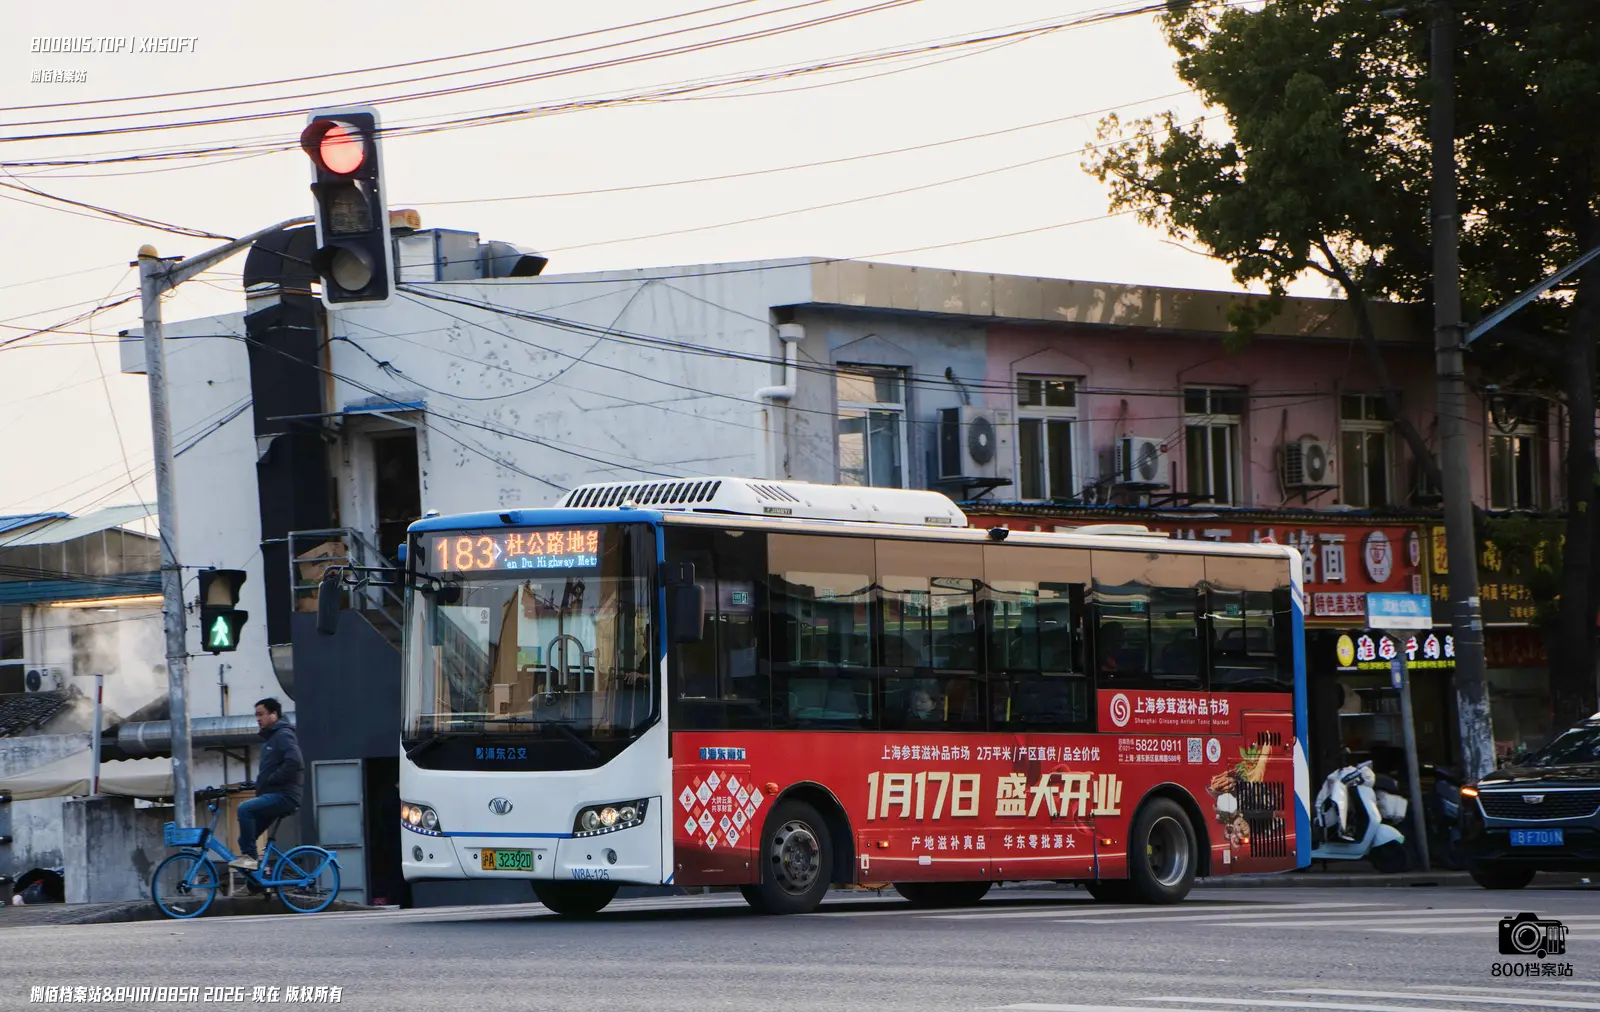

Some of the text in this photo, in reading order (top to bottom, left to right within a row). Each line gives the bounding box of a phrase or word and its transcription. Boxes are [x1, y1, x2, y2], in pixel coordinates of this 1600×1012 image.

[437, 535, 496, 571] 183
[521, 557, 533, 568] Du
[536, 555, 574, 569] Highway
[1134, 696, 1229, 716] 上海参茸滋补品市场
[1134, 717, 1157, 725] Shanghai
[1158, 718, 1179, 726] Ginseng
[881, 745, 971, 761] 上海参茸滋补品市场
[1135, 739, 1182, 752] 5822 0911
[867, 771, 1123, 820] 1月17日 盛大开业
[911, 834, 1076, 850] 产地滋补真品 华东零批源头
[499, 852, 532, 868] 32392D
[571, 868, 610, 881] W8A-125
